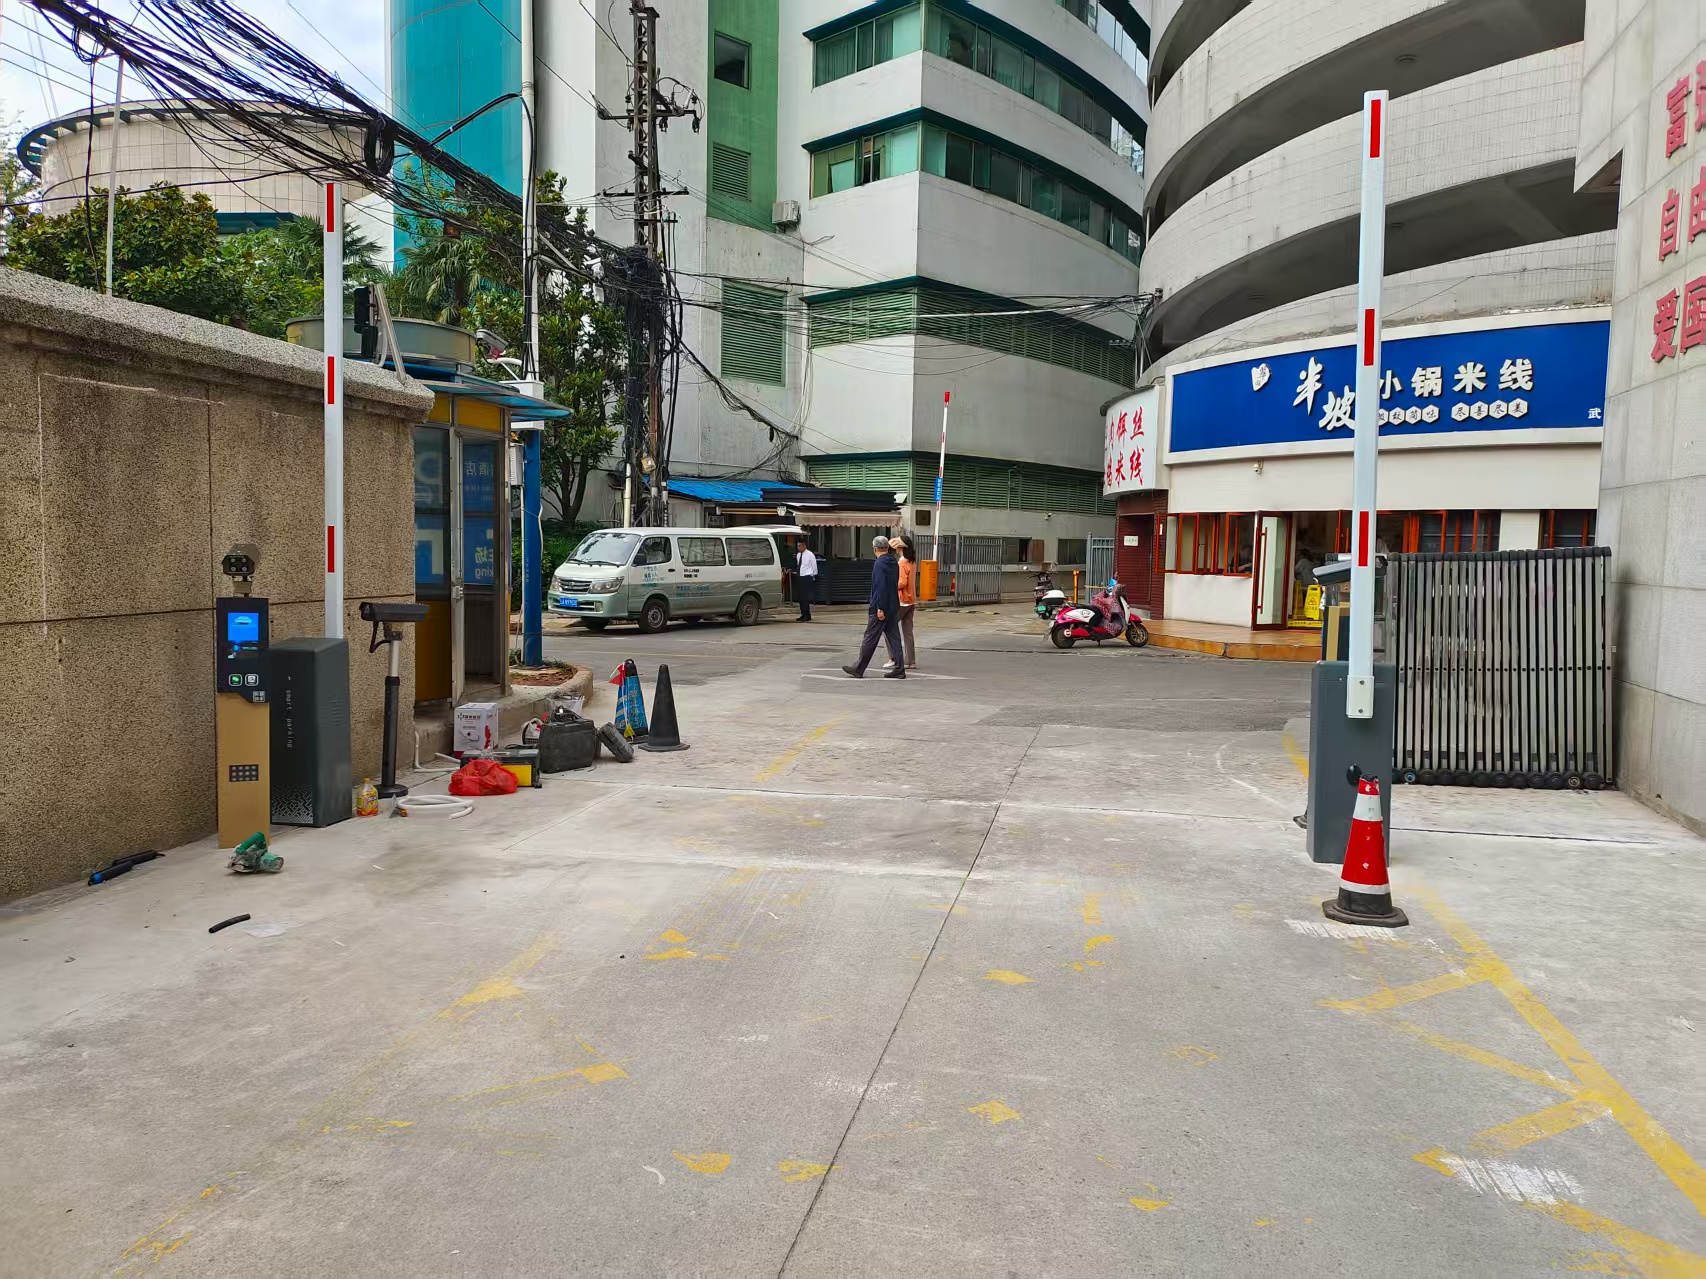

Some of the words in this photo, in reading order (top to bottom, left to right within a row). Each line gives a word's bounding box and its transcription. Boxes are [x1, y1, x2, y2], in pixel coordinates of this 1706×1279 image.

[1650, 275, 1706, 364] 爱国
[1378, 358, 1534, 400] 小锅米线
[1453, 400, 1525, 419] 尽善尽美
[1587, 407, 1602, 420] 武
